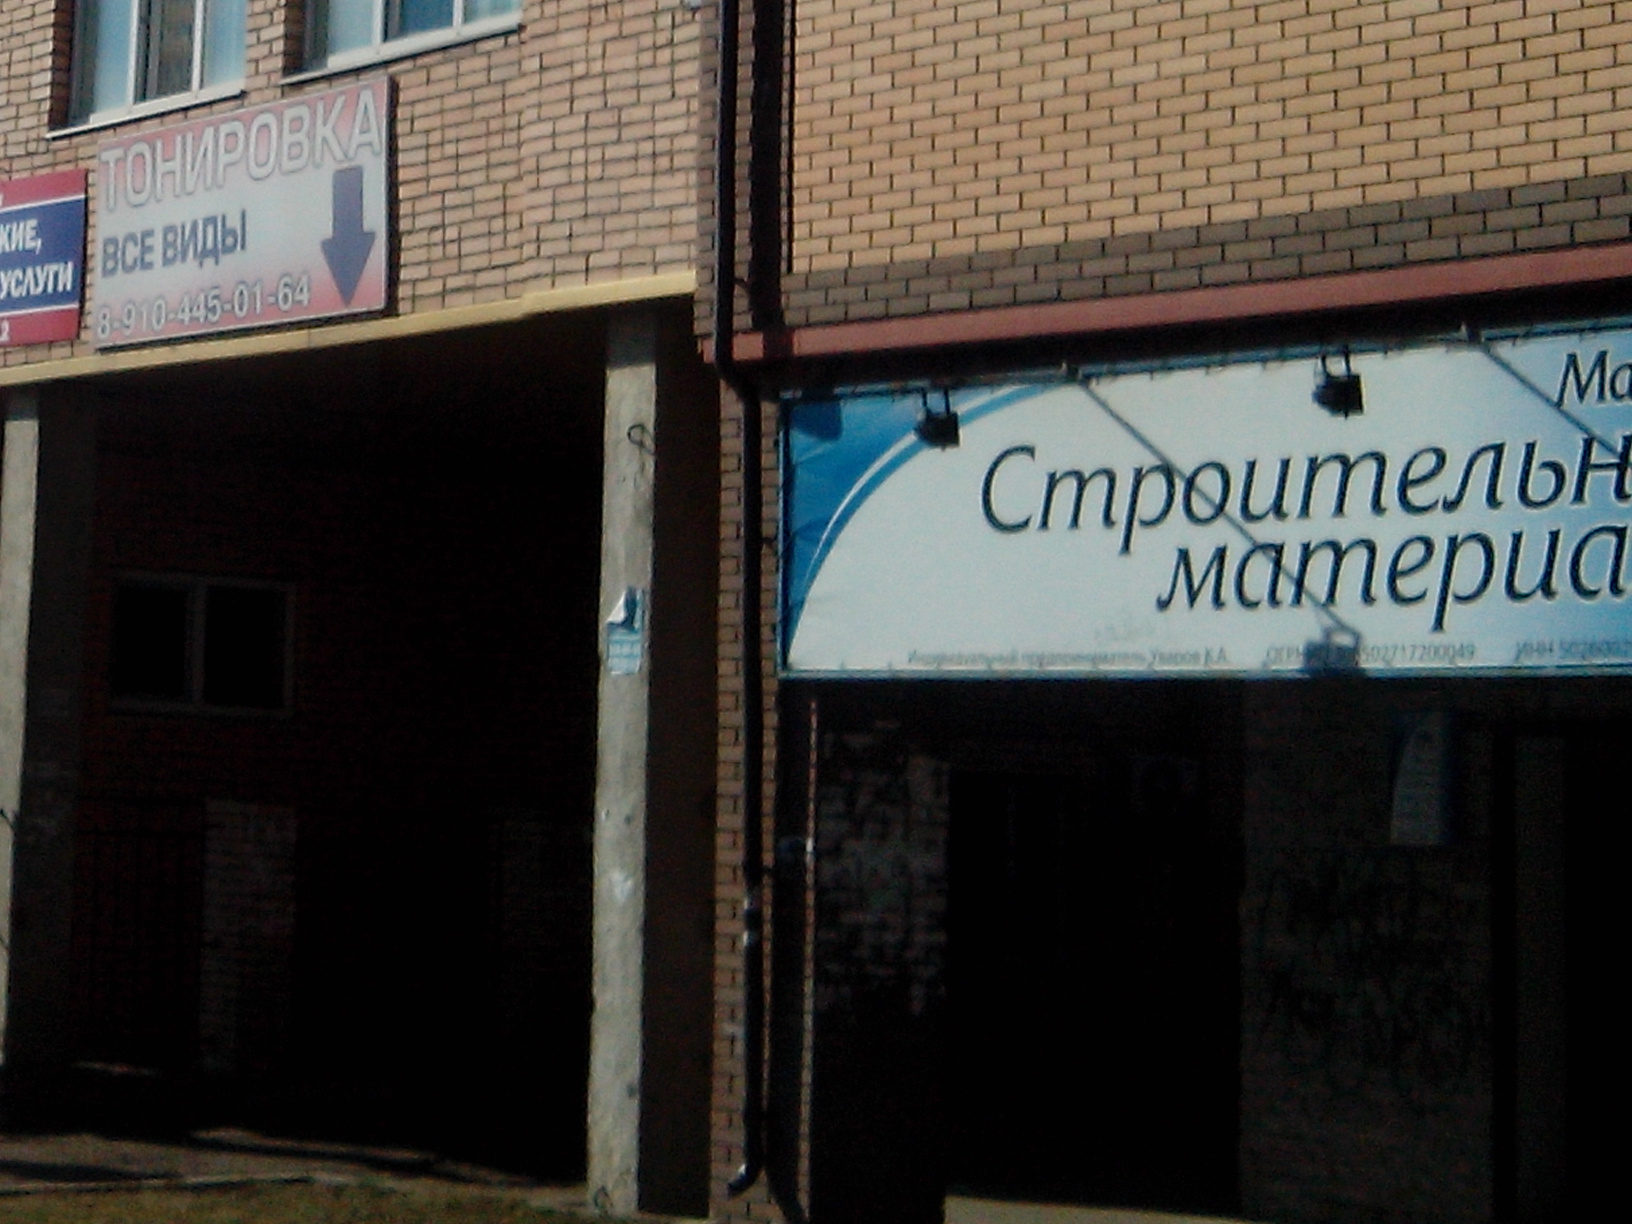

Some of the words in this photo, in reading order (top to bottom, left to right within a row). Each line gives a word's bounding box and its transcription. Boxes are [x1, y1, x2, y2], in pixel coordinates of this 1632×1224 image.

[100, 87, 384, 213] ТОНИРОВКА
[101, 228, 156, 279] ВСЕ
[161, 209, 247, 269] ВИДЫ
[96, 271, 311, 340] 8-910-445-01-64
[1156, 524, 1628, 633] материа
